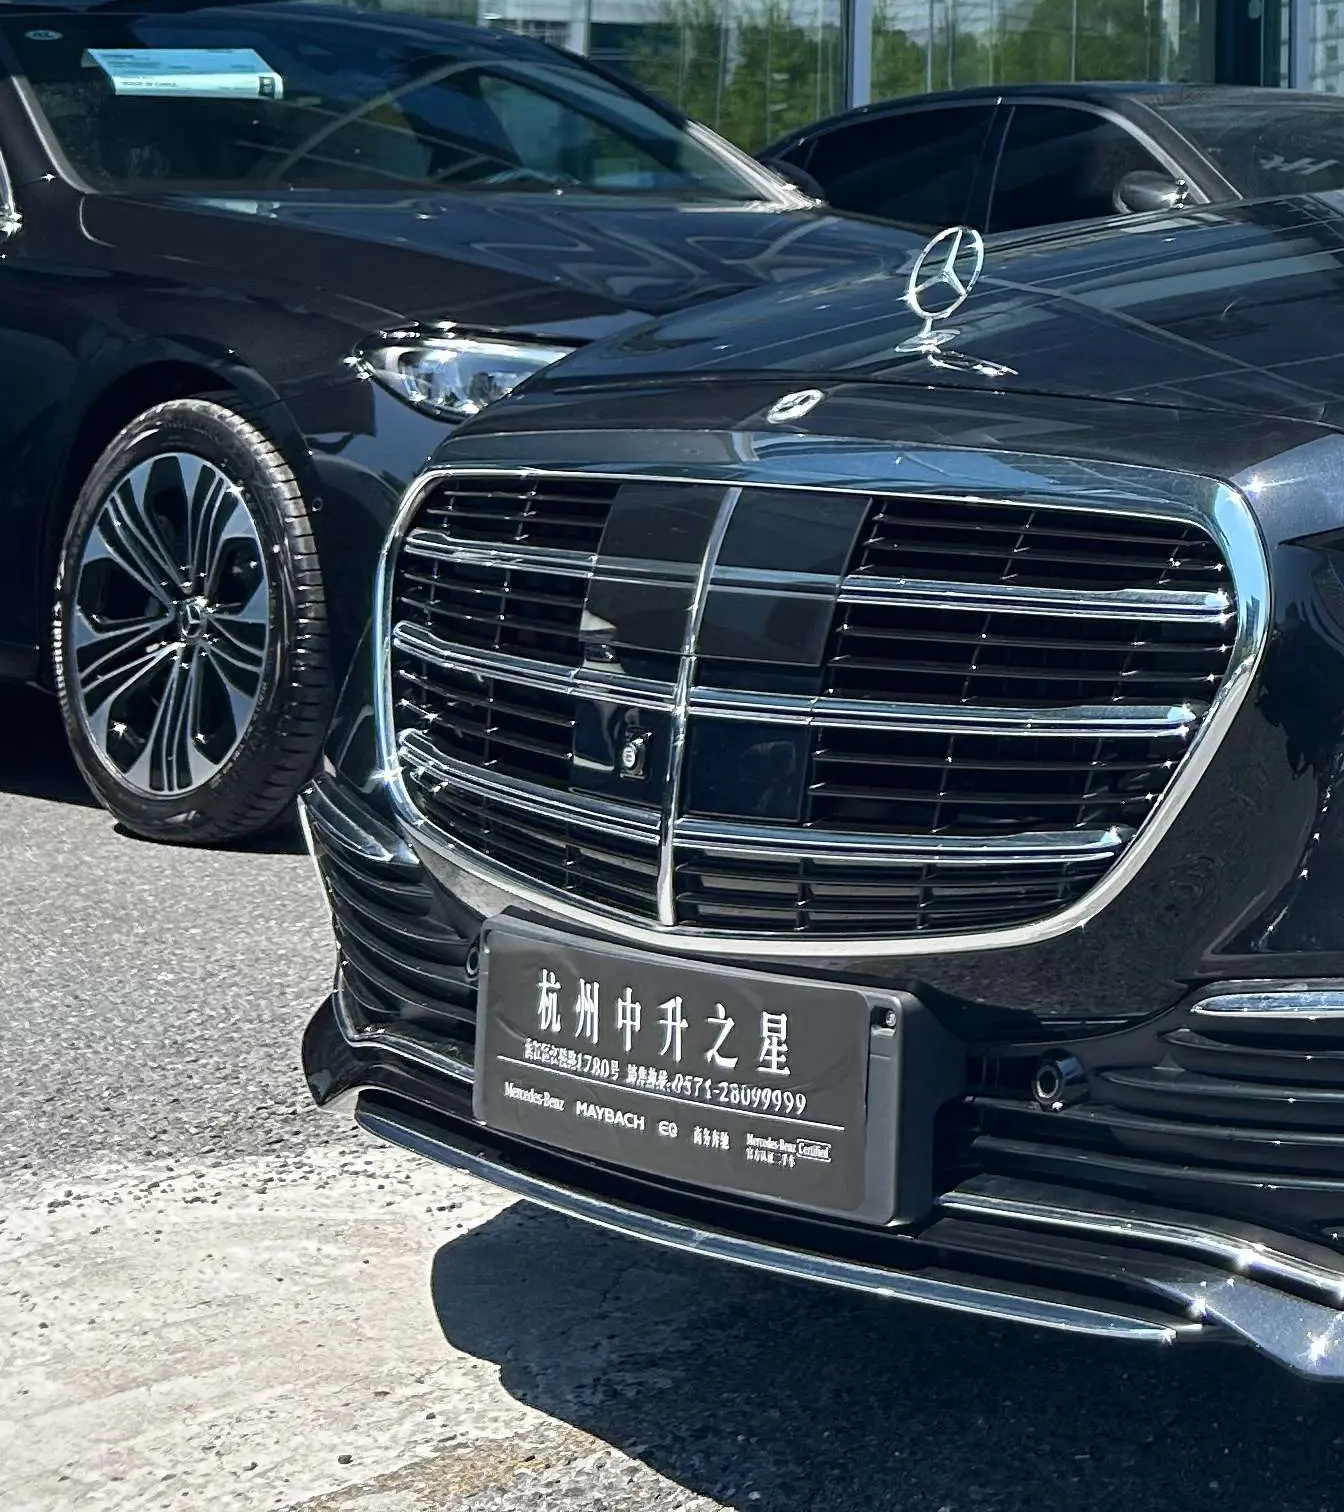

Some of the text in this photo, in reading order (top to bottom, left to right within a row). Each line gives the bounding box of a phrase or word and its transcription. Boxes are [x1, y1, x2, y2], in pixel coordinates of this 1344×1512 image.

[537, 968, 791, 1076] 杭州中升之星
[504, 1081, 565, 1112] Mercedes-Benz
[575, 1101, 646, 1131] MAYBACH
[658, 1120, 679, 1139] EQ
